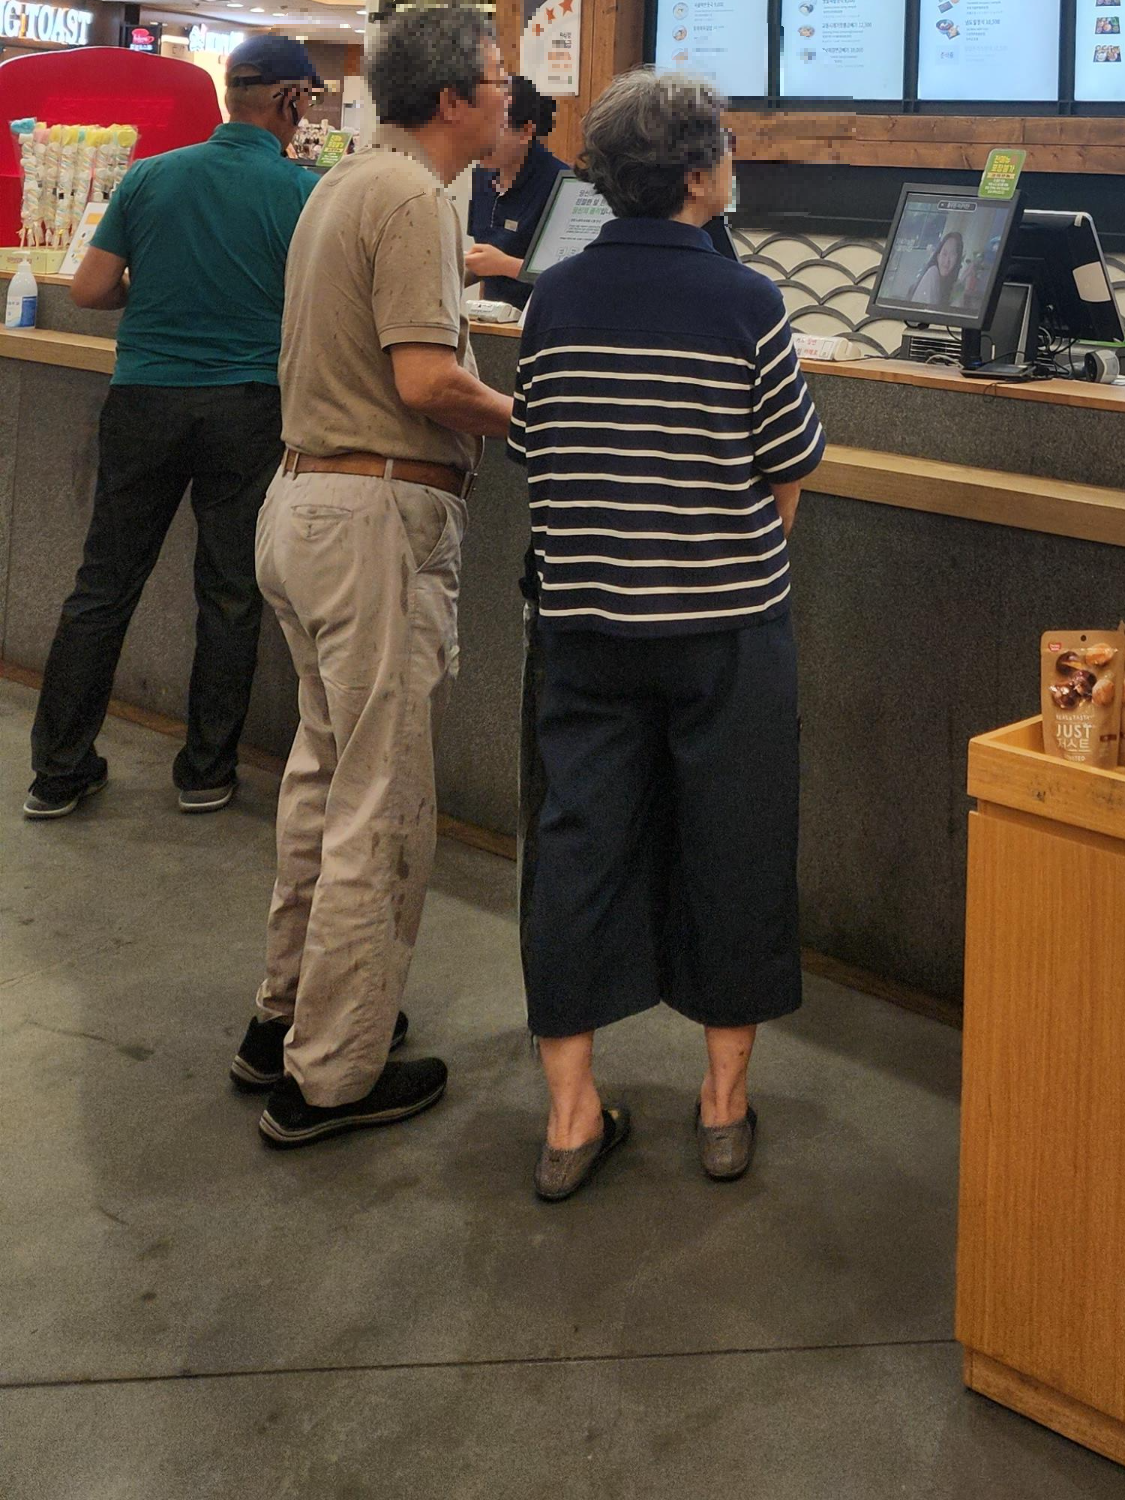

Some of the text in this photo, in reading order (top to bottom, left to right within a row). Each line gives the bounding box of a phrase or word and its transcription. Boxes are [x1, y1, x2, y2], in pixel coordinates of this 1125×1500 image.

[26, 4, 91, 46] TOAST
[1056, 722, 1093, 739] JUST
[1056, 737, 1090, 749] 저스트
